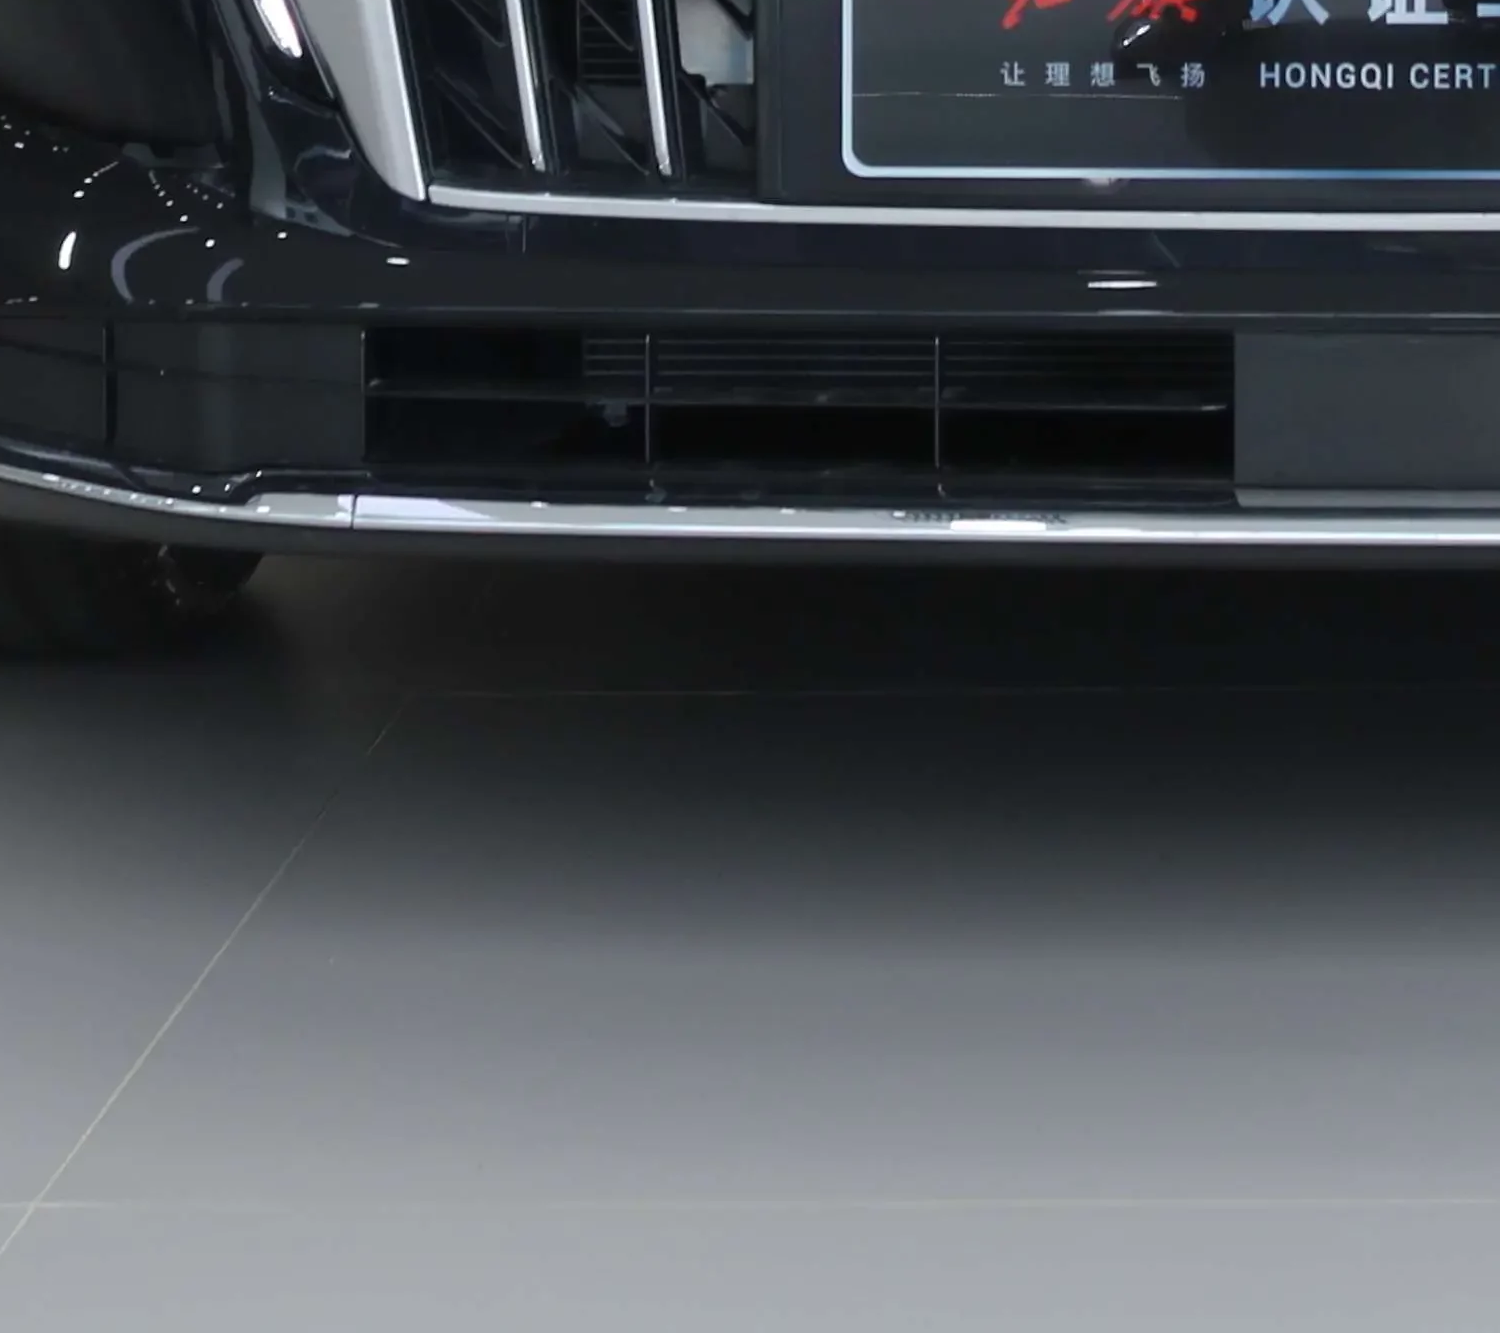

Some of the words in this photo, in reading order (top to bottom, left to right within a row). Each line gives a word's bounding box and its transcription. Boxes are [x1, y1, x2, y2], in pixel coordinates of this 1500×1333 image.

[999, 61, 1206, 88] 让理想飞扬
[1259, 61, 1395, 91] HONGQI
